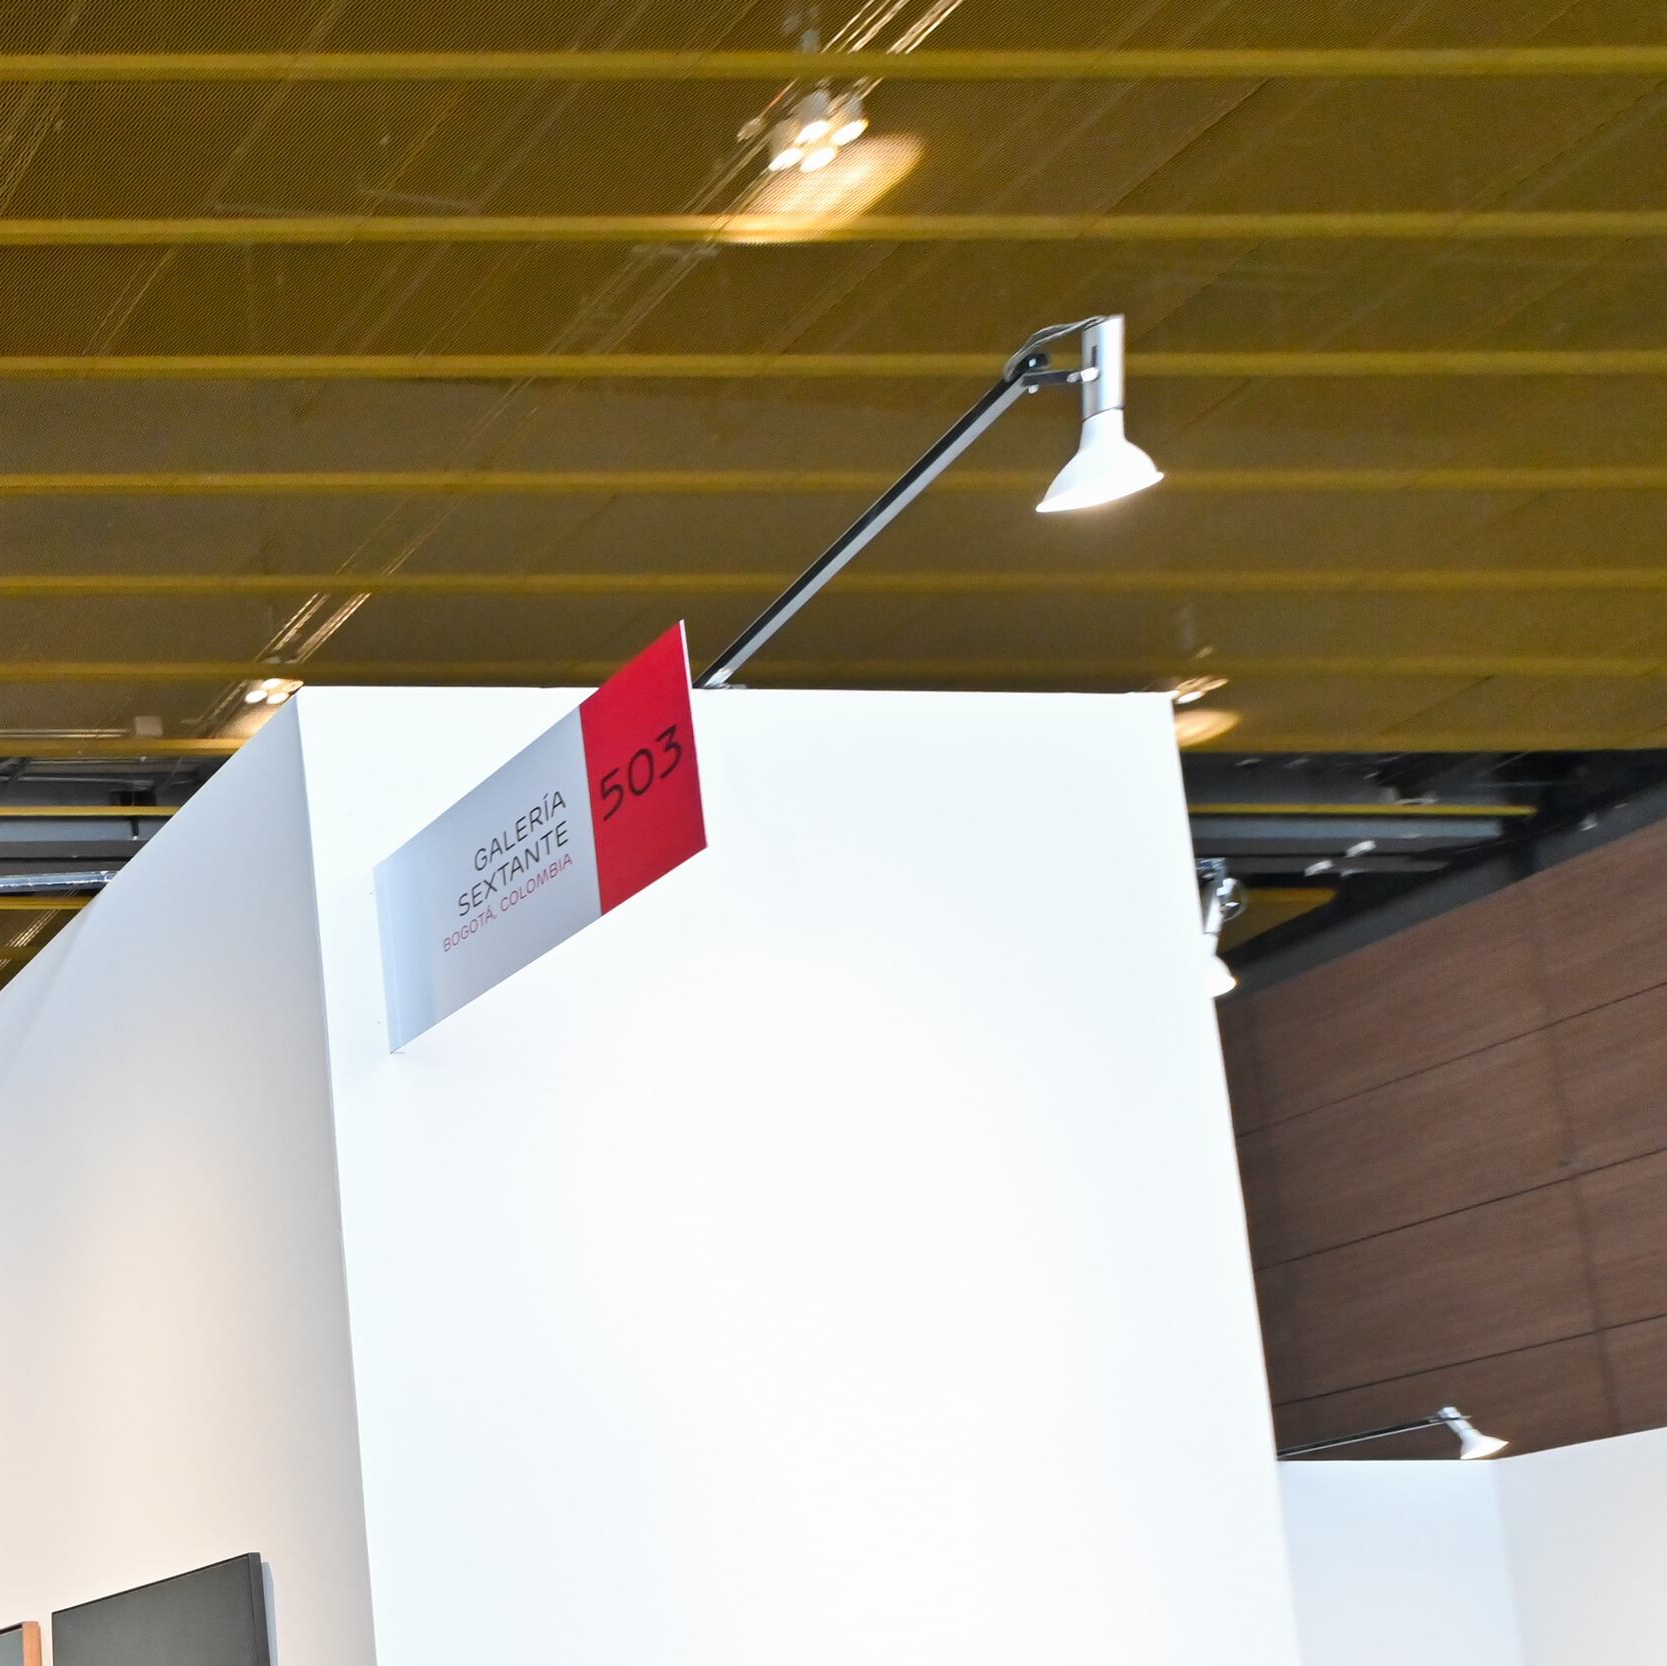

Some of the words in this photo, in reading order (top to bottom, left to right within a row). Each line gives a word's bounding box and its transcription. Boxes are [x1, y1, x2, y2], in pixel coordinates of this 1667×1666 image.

[601, 724, 683, 821] 503
[457, 820, 569, 917] SEXTANTE
[474, 790, 566, 872] GALERÍA
[443, 904, 497, 952] BOGOTÁ,
[500, 853, 573, 913] COLOMBIA
